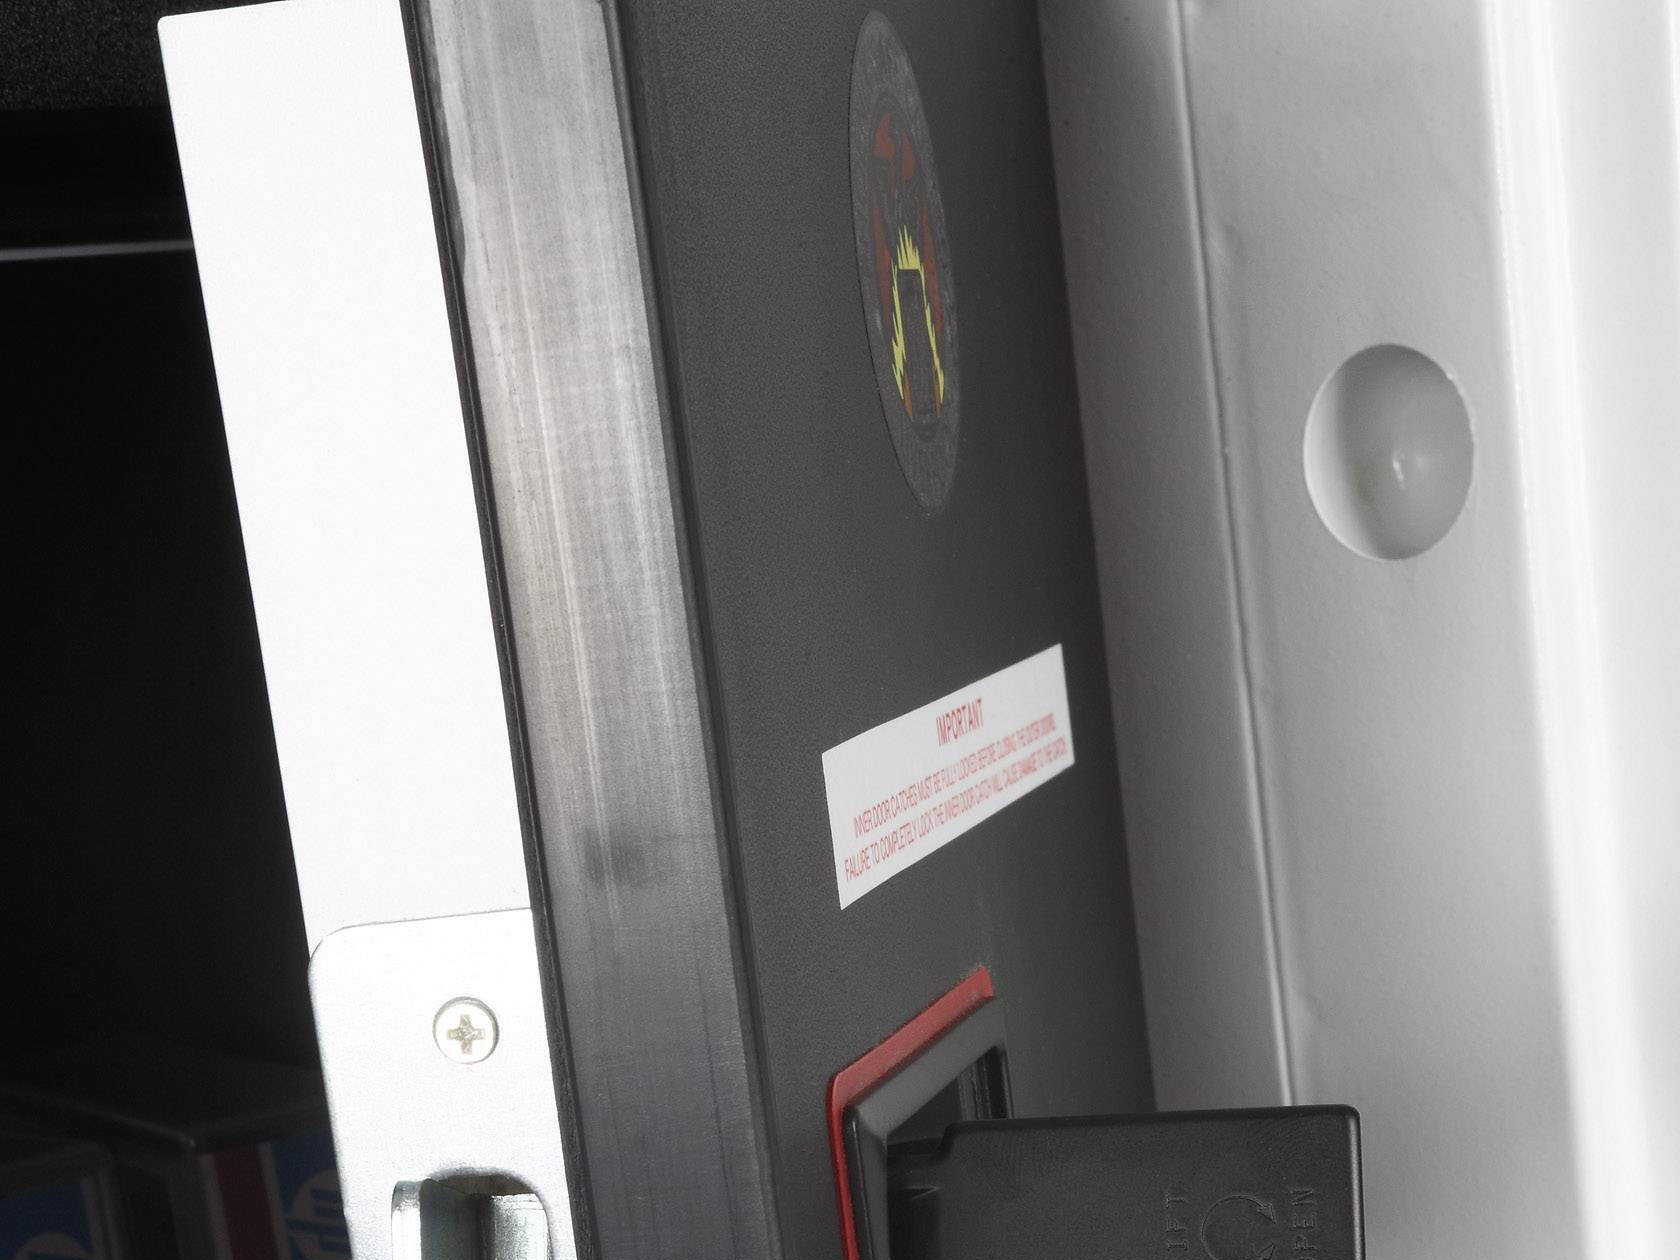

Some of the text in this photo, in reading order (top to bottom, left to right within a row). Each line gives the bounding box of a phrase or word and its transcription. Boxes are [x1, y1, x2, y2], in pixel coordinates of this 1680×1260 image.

[936, 698, 984, 746] IMPORTANT
[871, 797, 891, 828] DOOR
[889, 783, 918, 818] CATCHES
[931, 771, 941, 795] BE
[843, 845, 871, 883] FAILURE
[869, 840, 880, 867] TO
[878, 818, 919, 862] COMPLETELY
[916, 809, 934, 839] LOCK
[931, 803, 945, 830] THE
